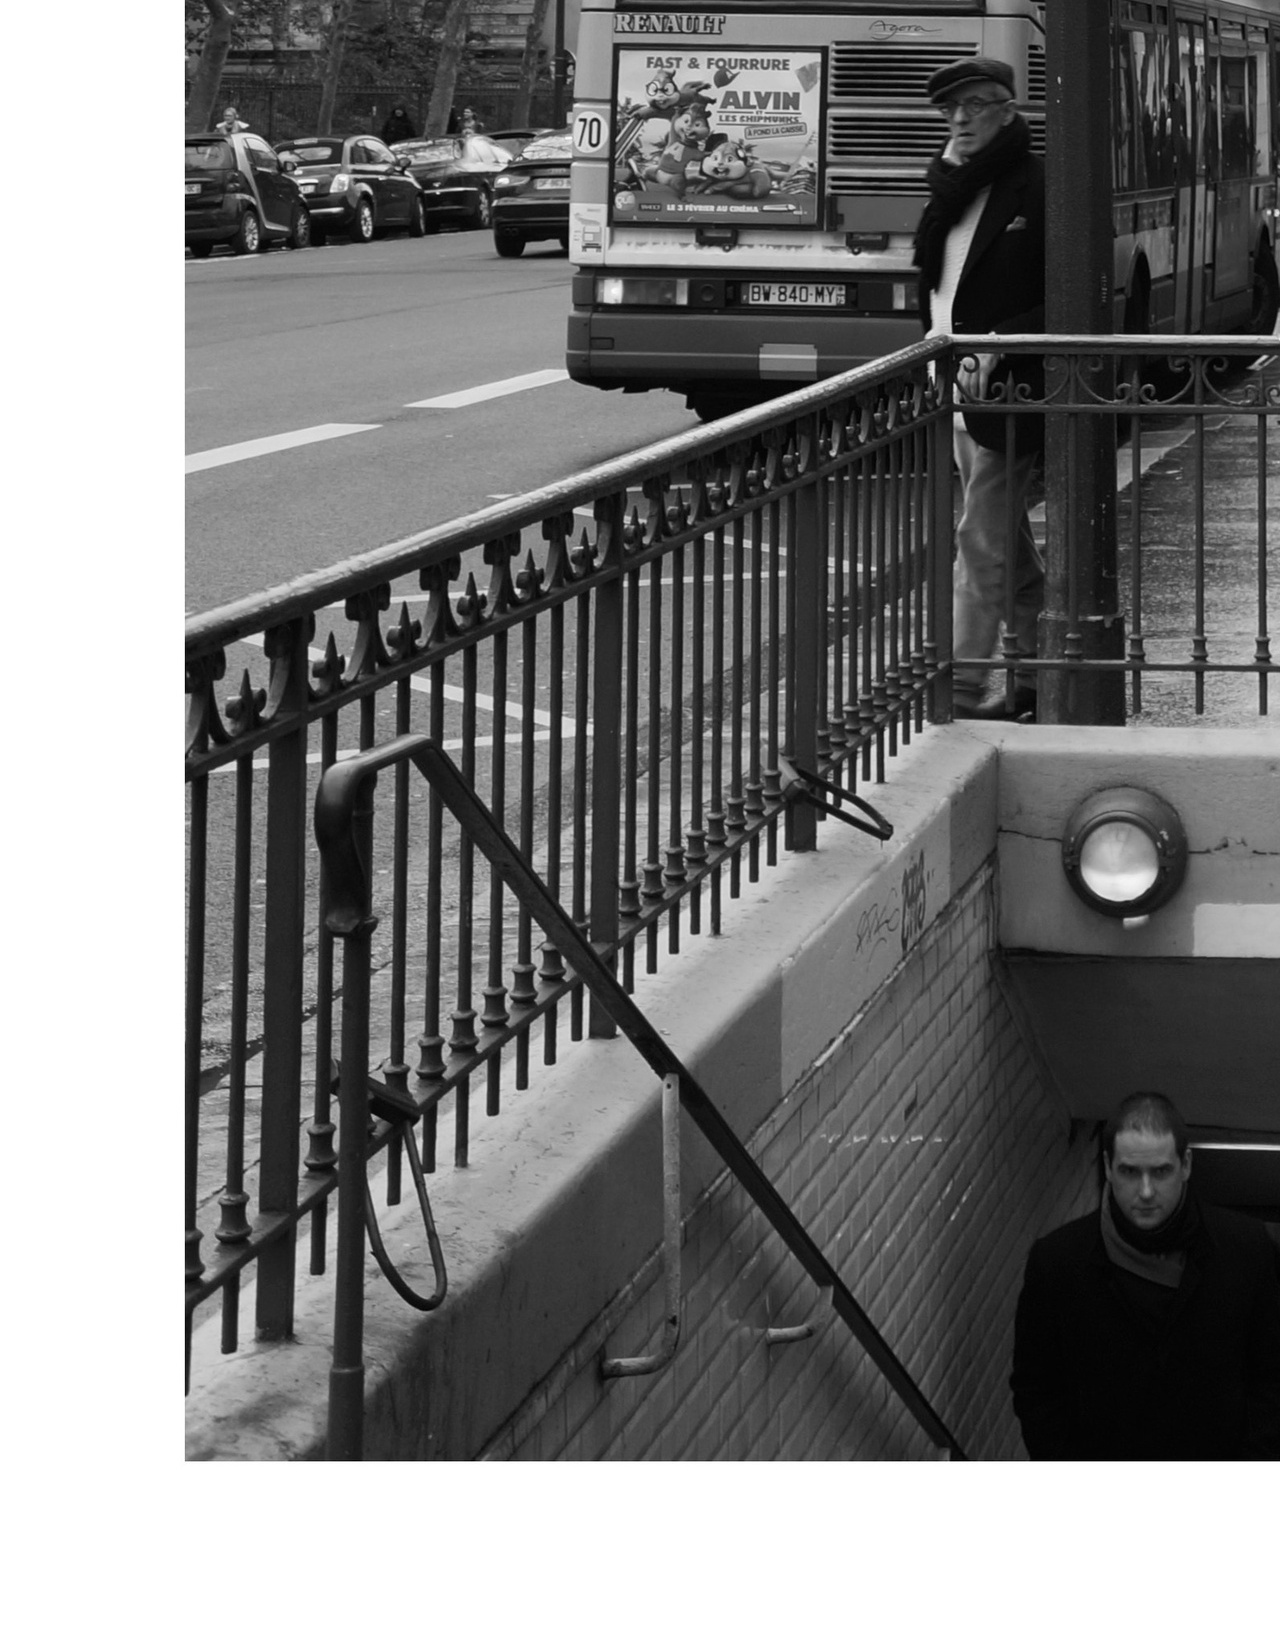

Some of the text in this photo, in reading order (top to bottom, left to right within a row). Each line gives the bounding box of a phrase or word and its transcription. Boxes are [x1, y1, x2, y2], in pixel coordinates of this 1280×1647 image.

[614, 14, 726, 35] RENAULT
[868, 19, 943, 41] Agora
[646, 56, 790, 71] FAST & FOURRURE
[719, 90, 800, 111] ALVIN
[718, 114, 800, 124] LES CHIPMUNKS
[578, 118, 601, 148] 70
[753, 128, 771, 136] FOND
[666, 204, 675, 212] LE
[677, 204, 683, 212] 3
[684, 203, 715, 212] FÉVRIER
[751, 285, 835, 304] BW-840-MY
